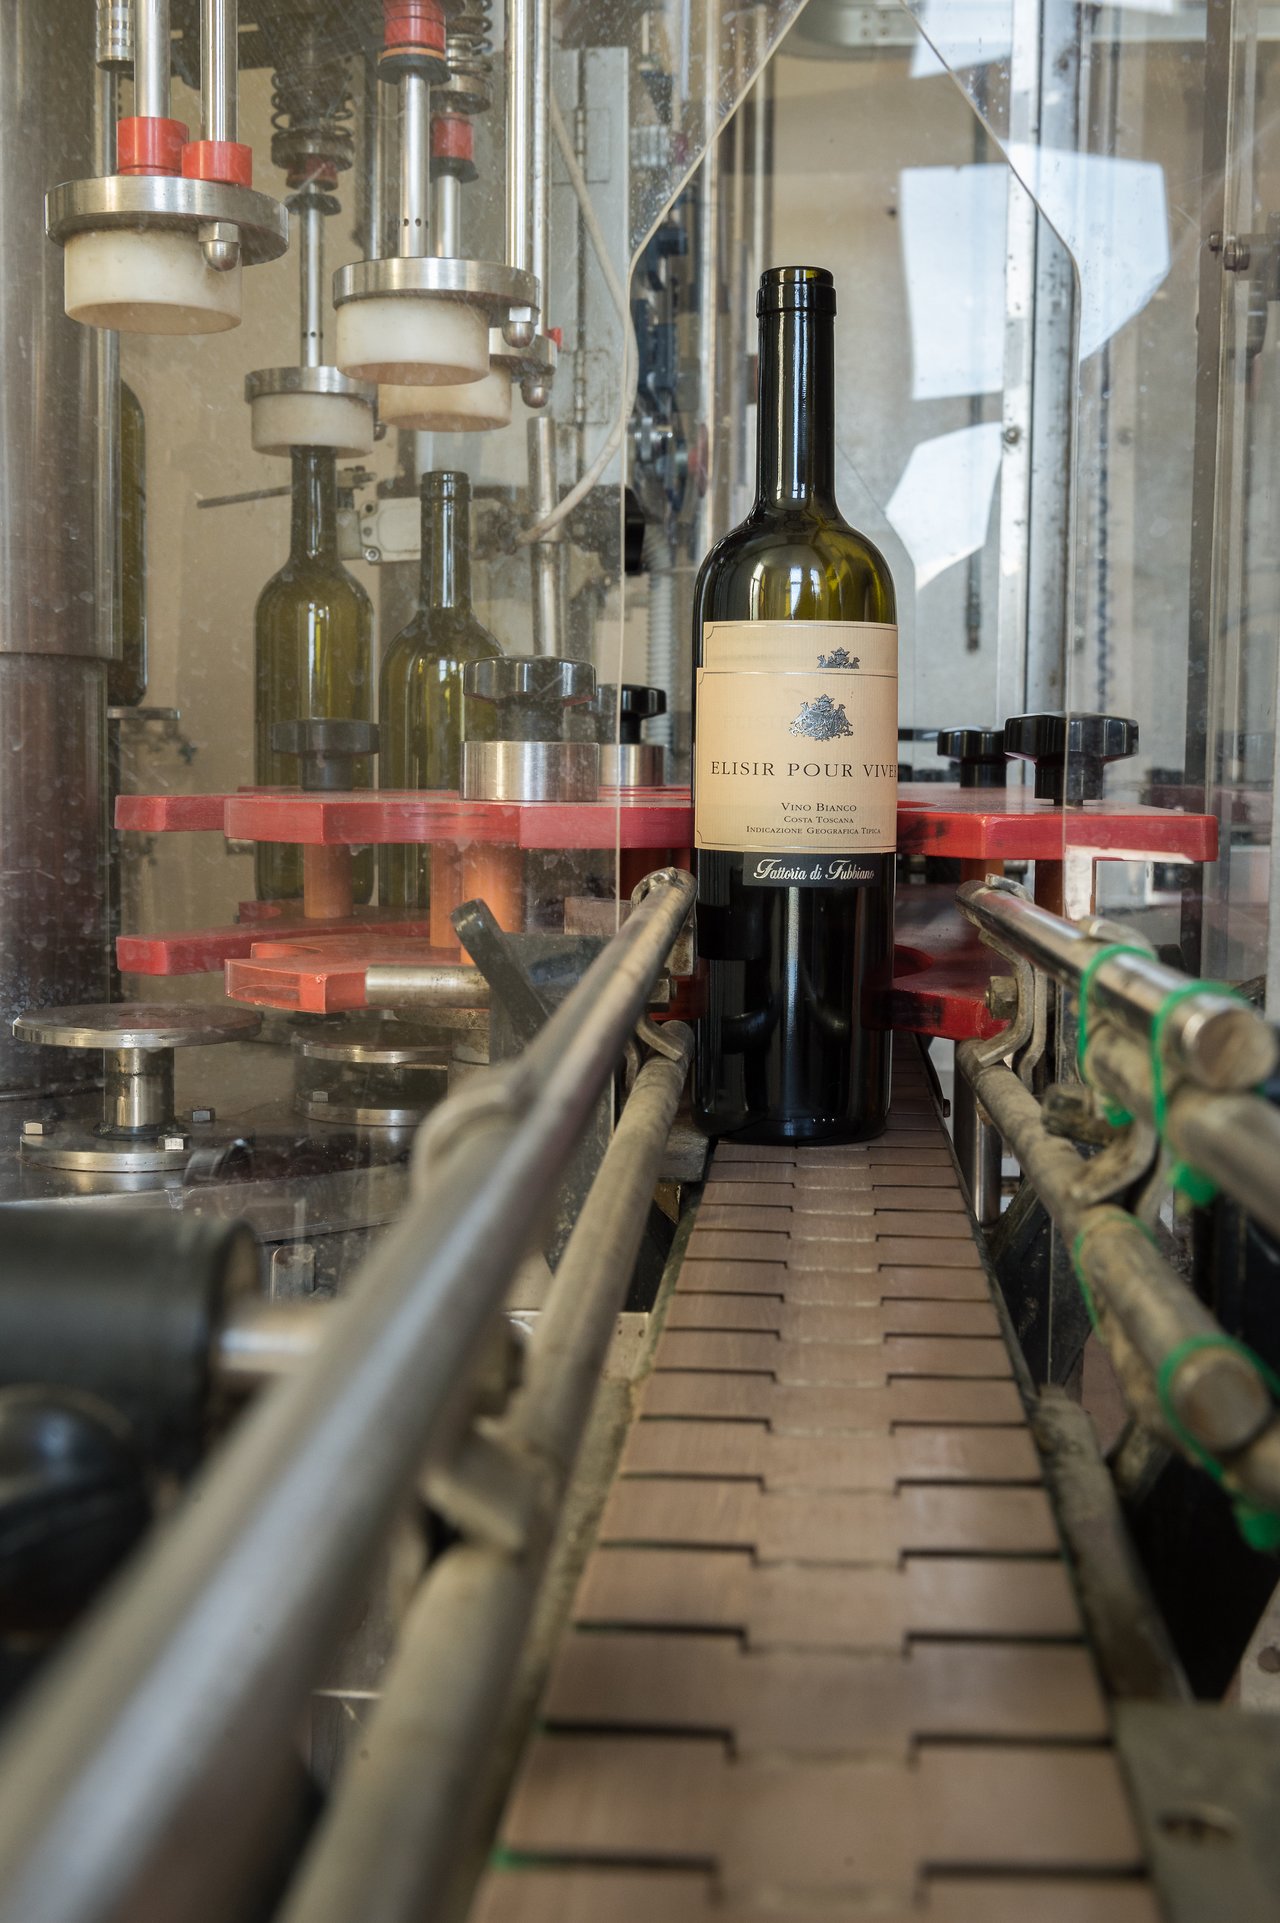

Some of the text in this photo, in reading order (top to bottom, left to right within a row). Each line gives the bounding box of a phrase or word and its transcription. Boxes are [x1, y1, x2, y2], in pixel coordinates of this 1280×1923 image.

[711, 761, 775, 776] ELISIR
[787, 763, 853, 777] POUR
[753, 859, 875, 880] Fattoria di Fubbiano
